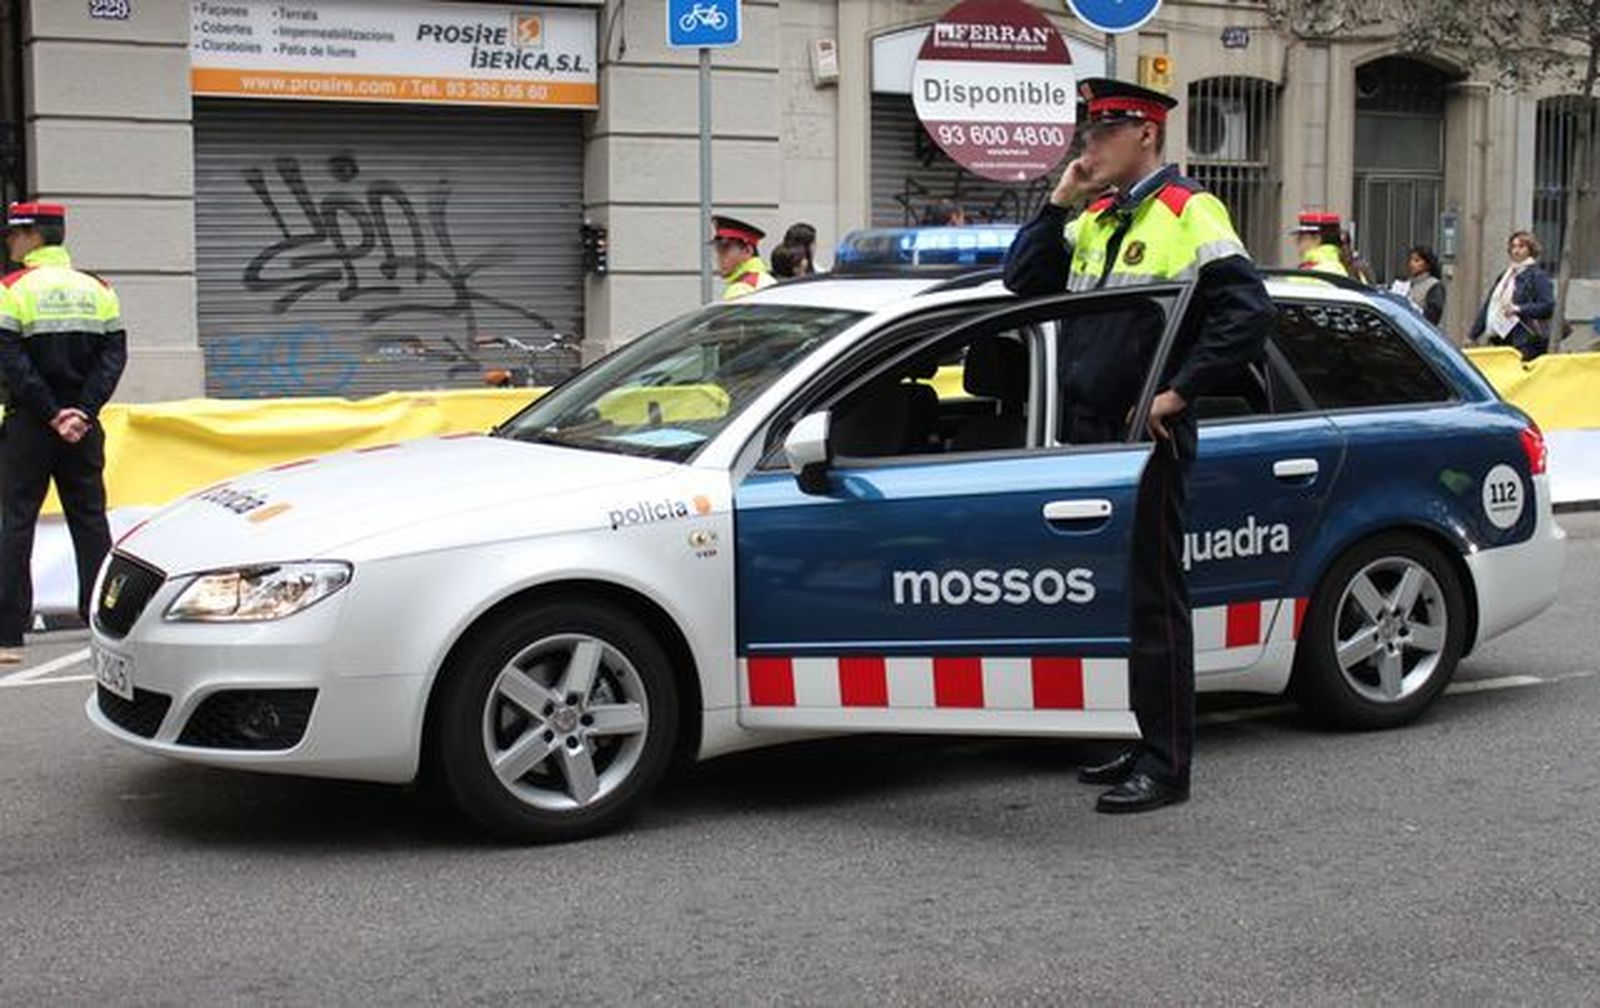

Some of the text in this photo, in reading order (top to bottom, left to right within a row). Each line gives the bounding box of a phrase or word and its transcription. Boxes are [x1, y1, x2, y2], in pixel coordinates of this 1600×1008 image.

[200, 21, 253, 36] Cobertes
[956, 23, 1049, 43] FERRAN
[309, 44, 323, 57] de
[240, 75, 397, 96] www.prosire.com
[923, 78, 1066, 109] Disponible
[937, 124, 966, 145] 93
[970, 125, 1008, 146] 600
[1489, 481, 1517, 503] 112
[609, 498, 689, 531] policia
[893, 567, 1097, 605] mossos
